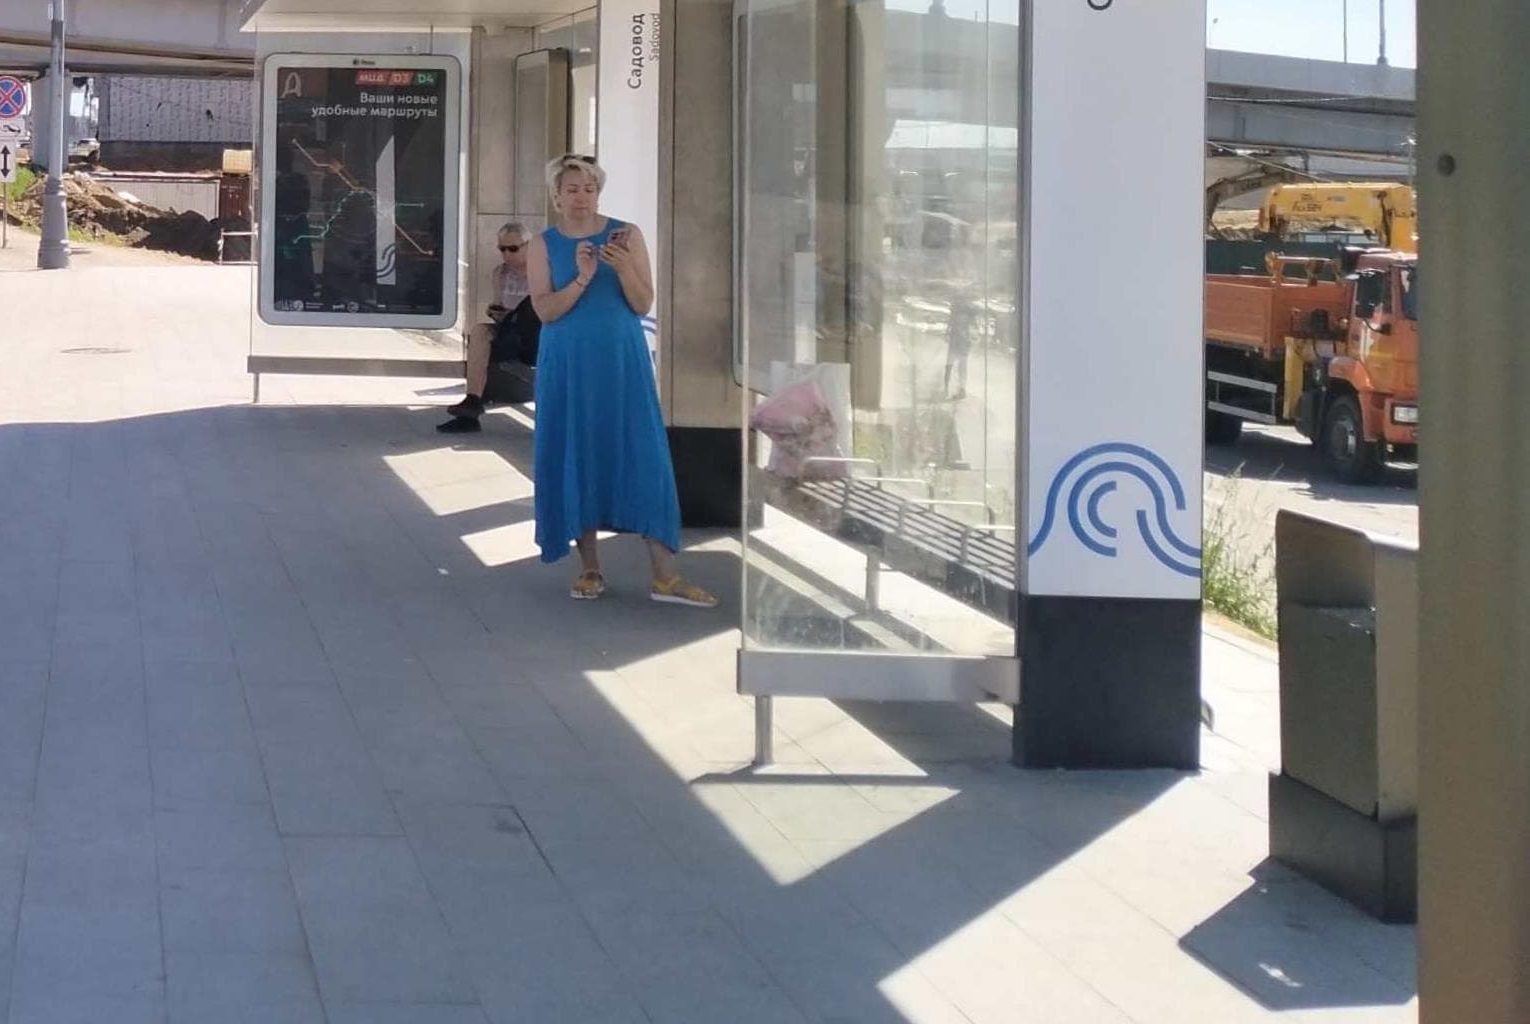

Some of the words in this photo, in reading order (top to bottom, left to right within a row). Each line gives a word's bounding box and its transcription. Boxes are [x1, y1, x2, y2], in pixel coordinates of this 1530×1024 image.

[648, 12, 660, 62] Sadovod
[627, 13, 645, 90] Садовод
[393, 74, 409, 83] D3
[417, 73, 435, 84] D4
[360, 92, 394, 104] Ваши
[397, 95, 438, 104] новые
[311, 104, 368, 118] удобные
[370, 108, 438, 119] маршруты
